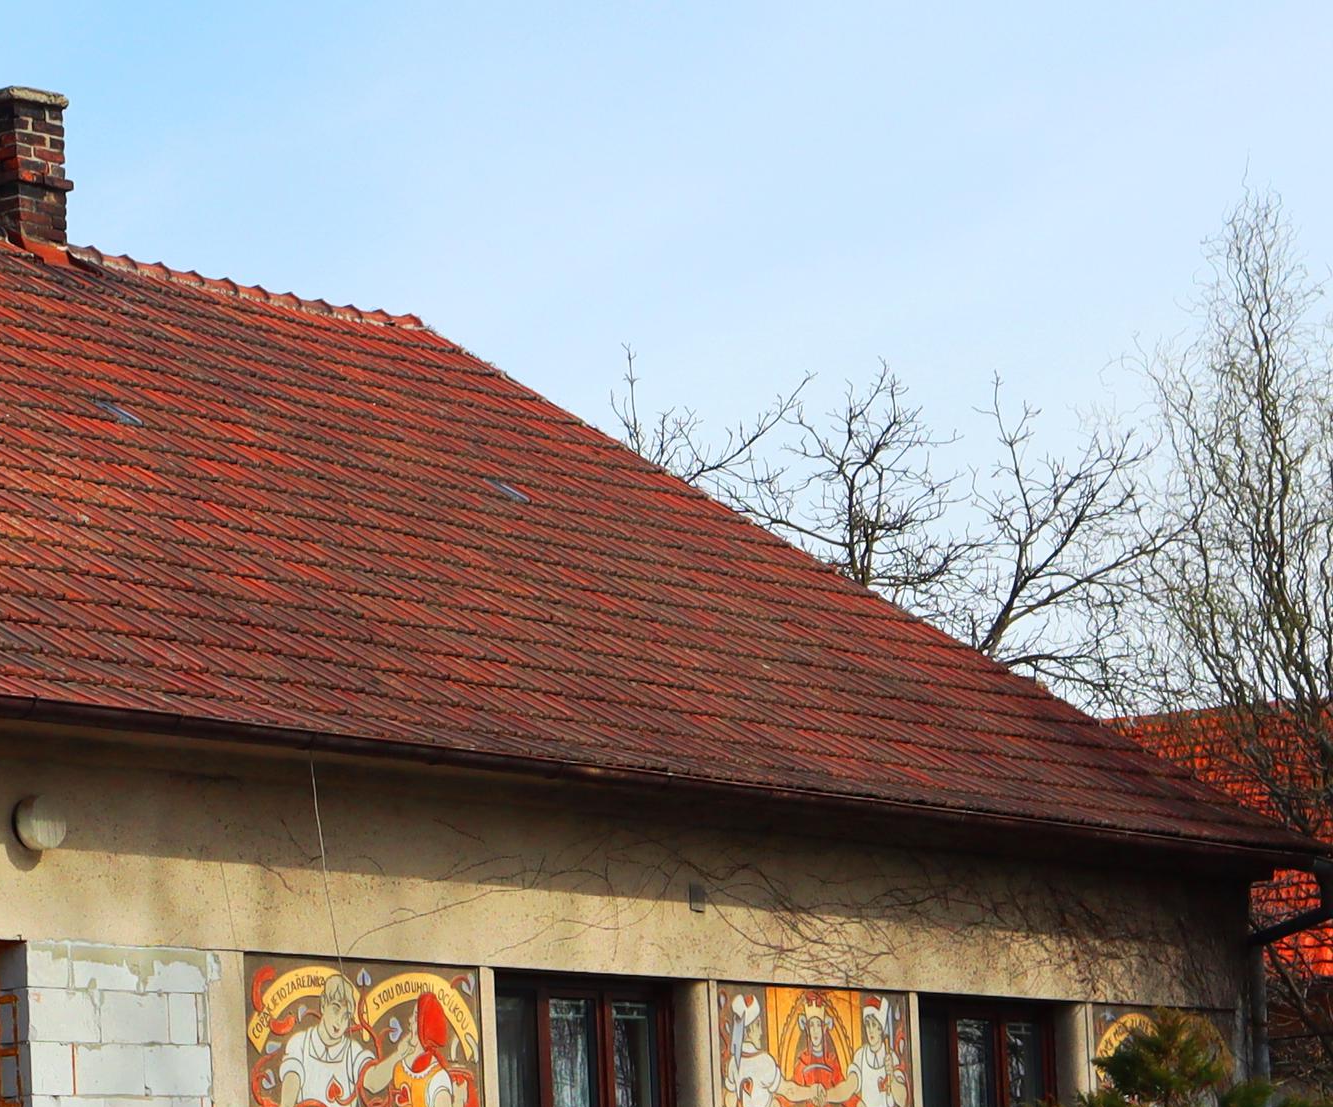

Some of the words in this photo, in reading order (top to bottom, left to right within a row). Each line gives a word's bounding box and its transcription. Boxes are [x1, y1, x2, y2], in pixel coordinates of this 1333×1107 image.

[276, 987, 287, 1000] TO
[286, 979, 297, 994] ZA
[373, 997, 380, 1010] S
[378, 987, 394, 1005] TOU
